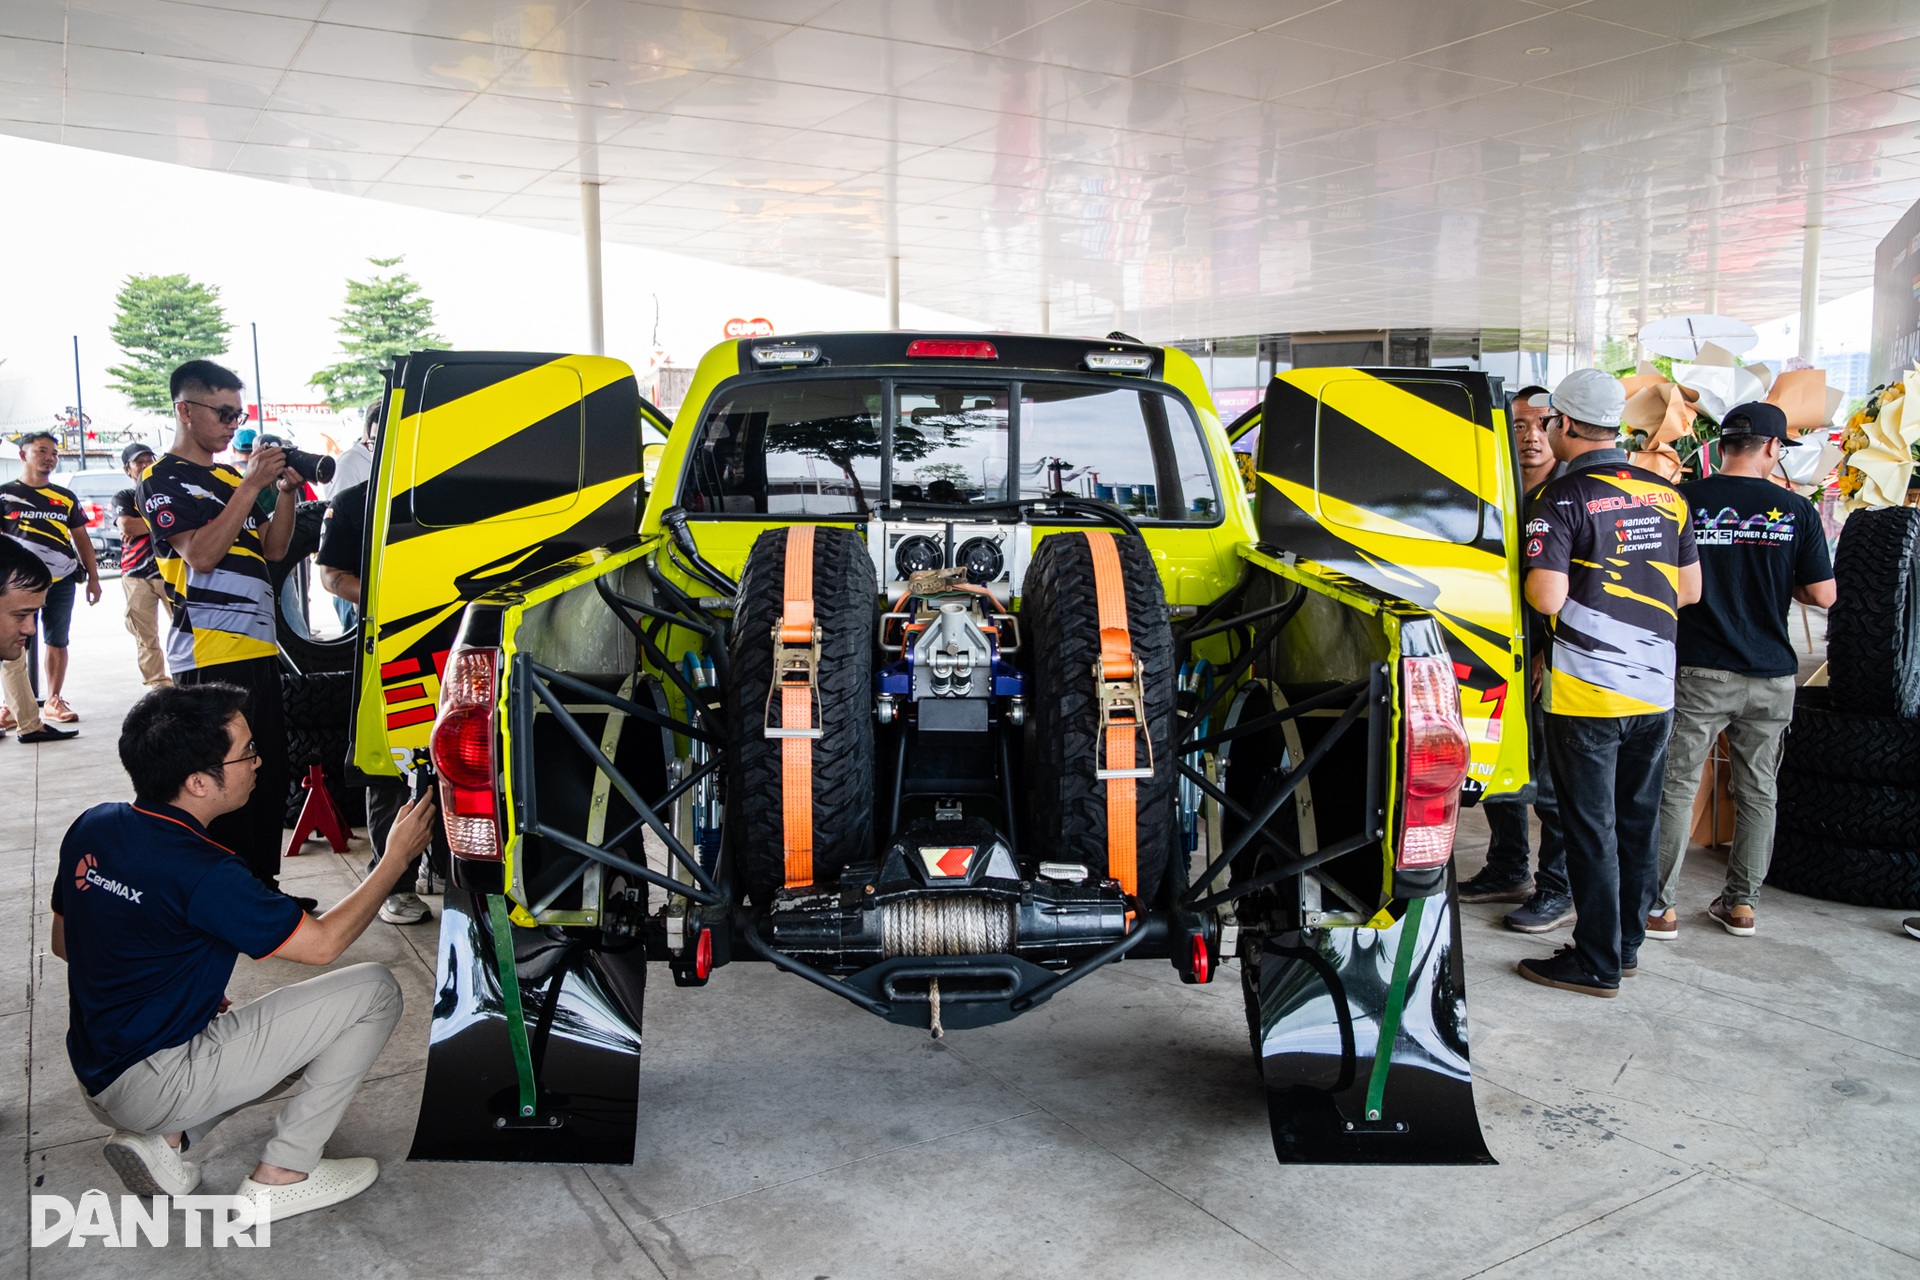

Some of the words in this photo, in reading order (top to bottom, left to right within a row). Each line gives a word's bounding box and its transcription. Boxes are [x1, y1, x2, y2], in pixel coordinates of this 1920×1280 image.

[1238, 398, 1249, 406] LIST
[1586, 493, 1658, 515] REDLINE
[1694, 530, 1732, 541] HKS
[1734, 530, 1760, 539] POWER
[1761, 531, 1768, 539] &
[1769, 532, 1794, 541] SPORT
[85, 868, 144, 905] CeraMAX
